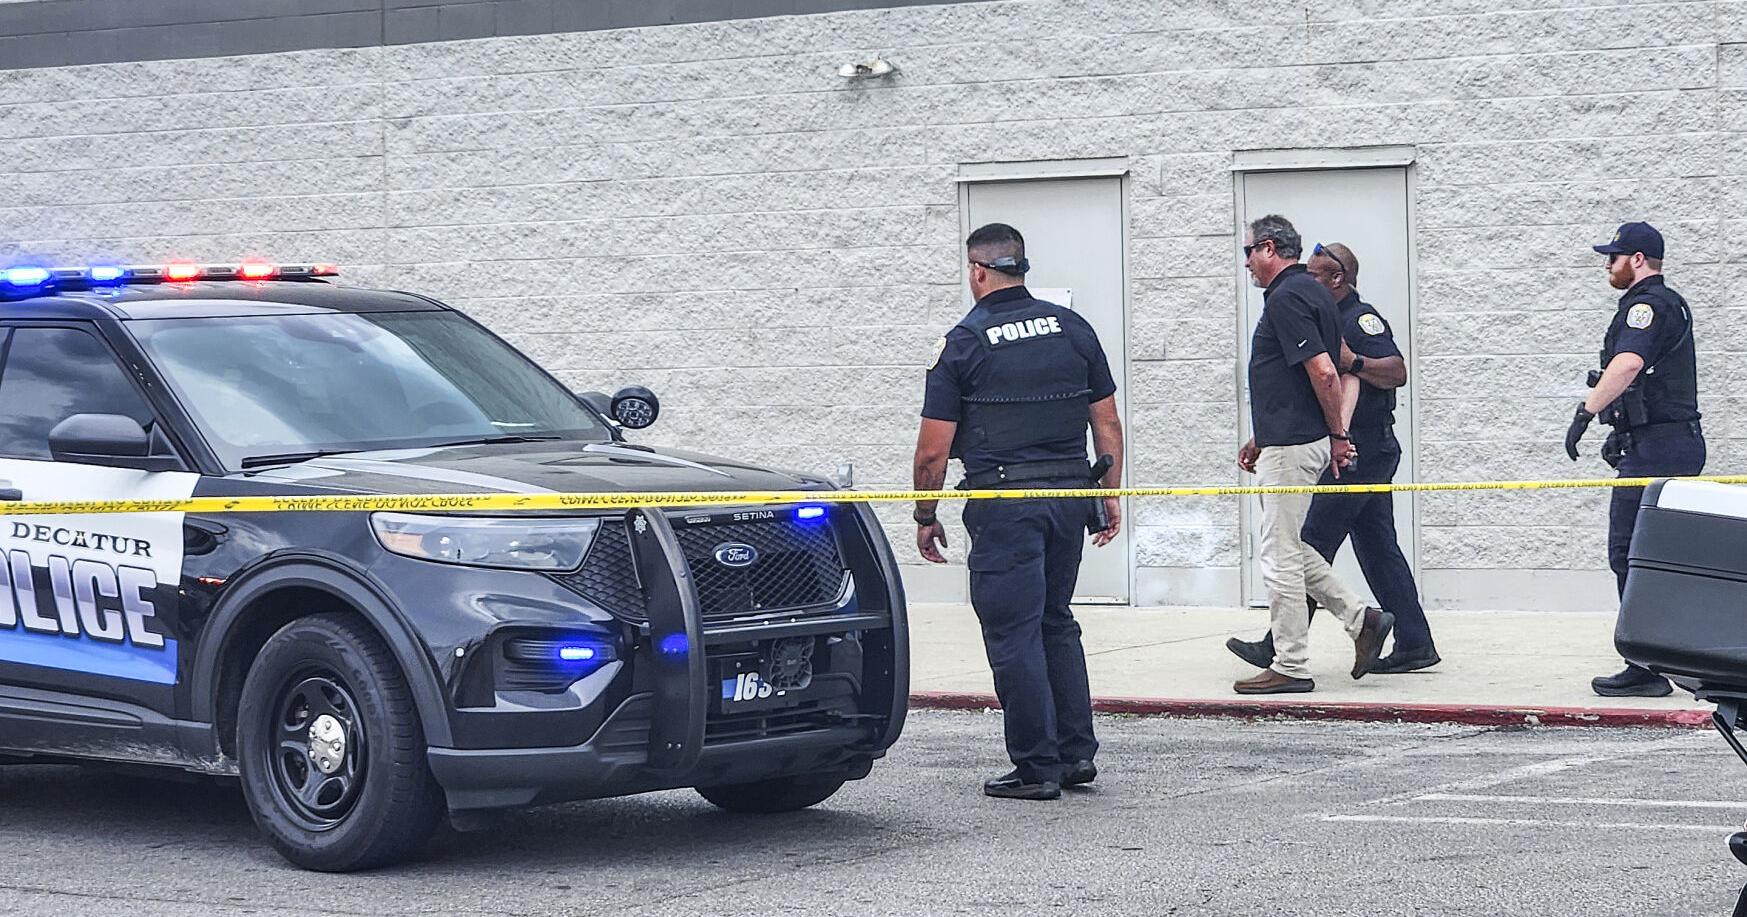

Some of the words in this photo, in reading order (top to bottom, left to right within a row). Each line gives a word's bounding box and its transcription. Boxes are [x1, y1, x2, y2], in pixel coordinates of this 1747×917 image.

[986, 316, 1062, 346] POLICE
[733, 510, 775, 521] SETINA
[12, 522, 152, 557] DECATUR
[728, 549, 750, 561] Ford
[734, 671, 786, 701] 163
